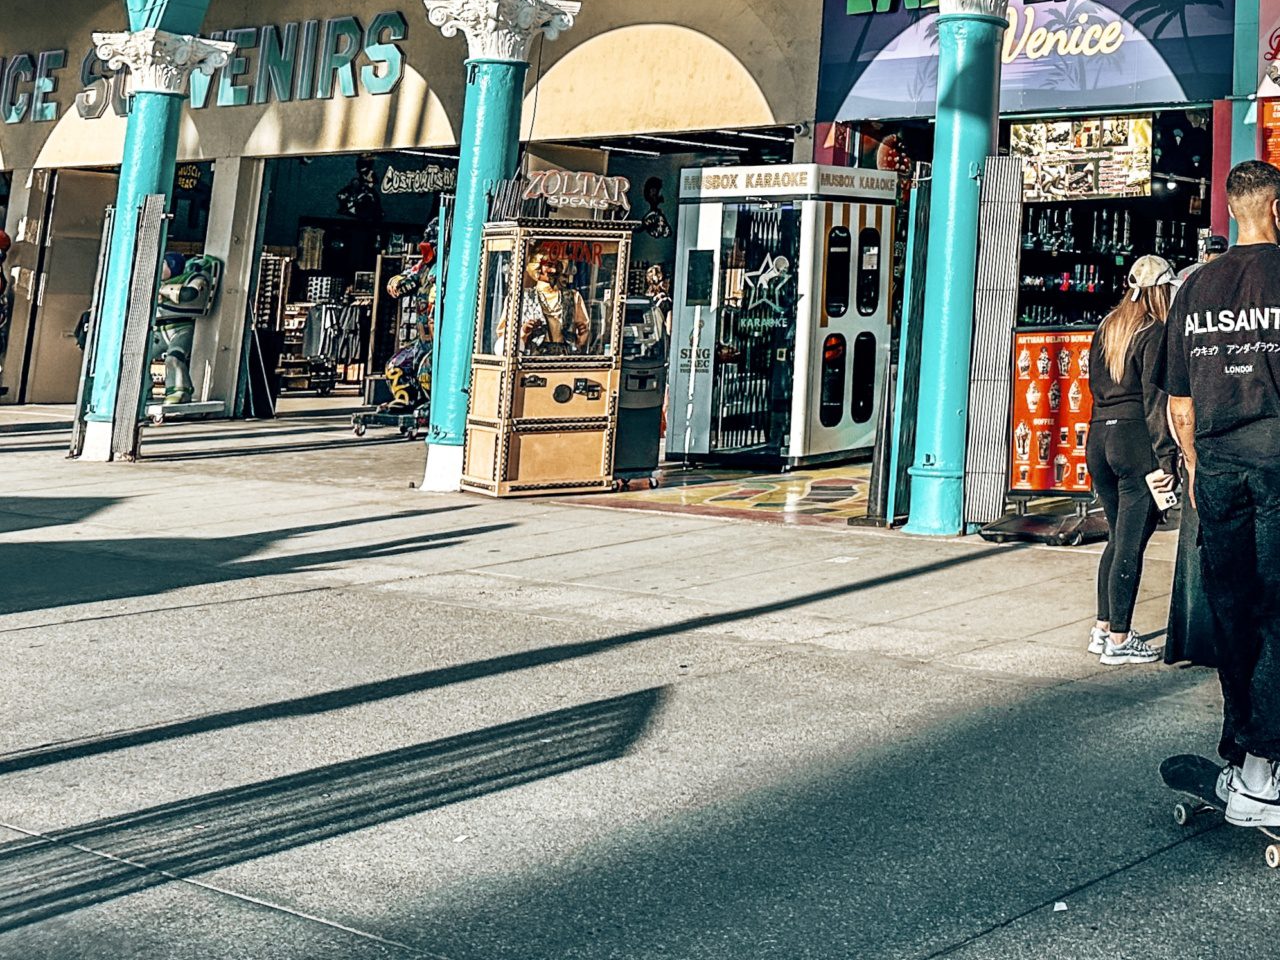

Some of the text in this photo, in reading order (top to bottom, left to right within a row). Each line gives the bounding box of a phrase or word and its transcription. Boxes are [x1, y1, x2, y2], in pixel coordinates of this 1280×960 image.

[1002, 5, 1125, 65] Venice
[521, 169, 631, 210] ZOLTAR
[684, 172, 808, 191] MUSBOX KARAOKE
[820, 173, 895, 191] MUSBOX KARAOKE
[548, 195, 609, 209] SPEAKS
[740, 318, 788, 328] KARAOKE
[1033, 418, 1055, 426] COFFEE
